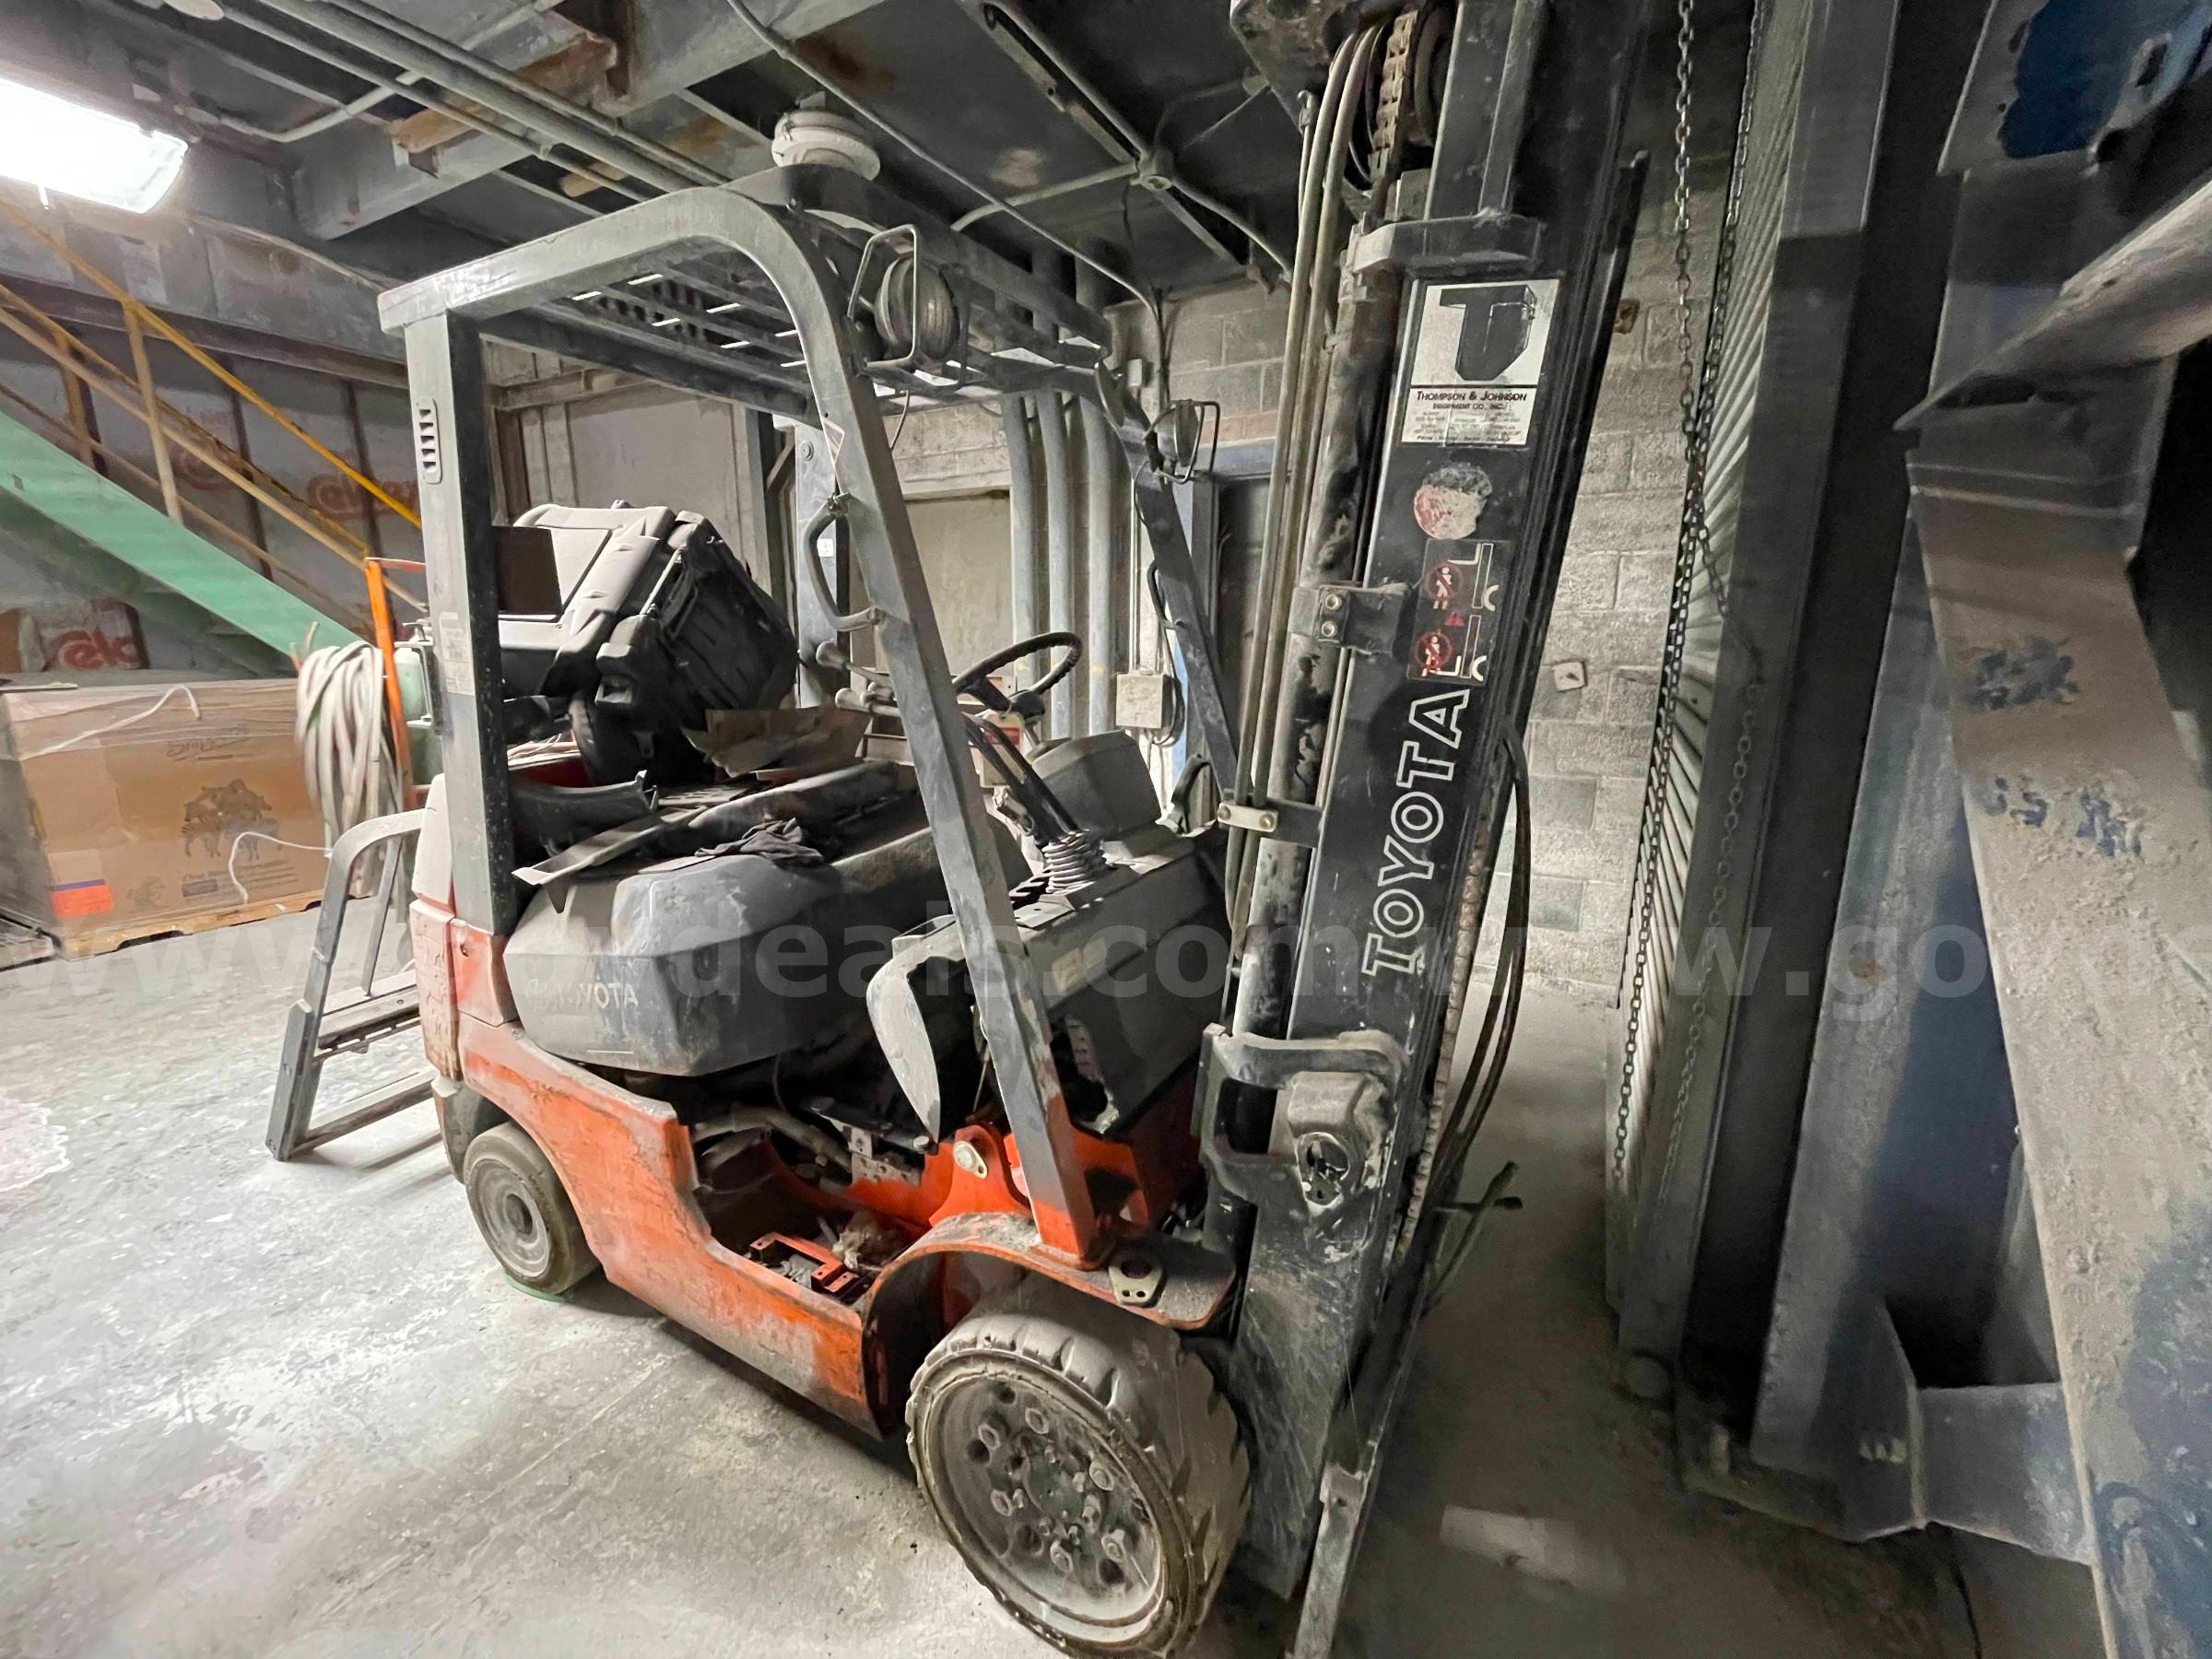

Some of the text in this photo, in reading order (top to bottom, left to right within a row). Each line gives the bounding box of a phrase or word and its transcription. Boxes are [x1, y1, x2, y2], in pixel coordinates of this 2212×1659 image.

[1417, 391, 1527, 402] THOMPSON & JOHNSON
[1361, 688, 1471, 976] TOYOTA
